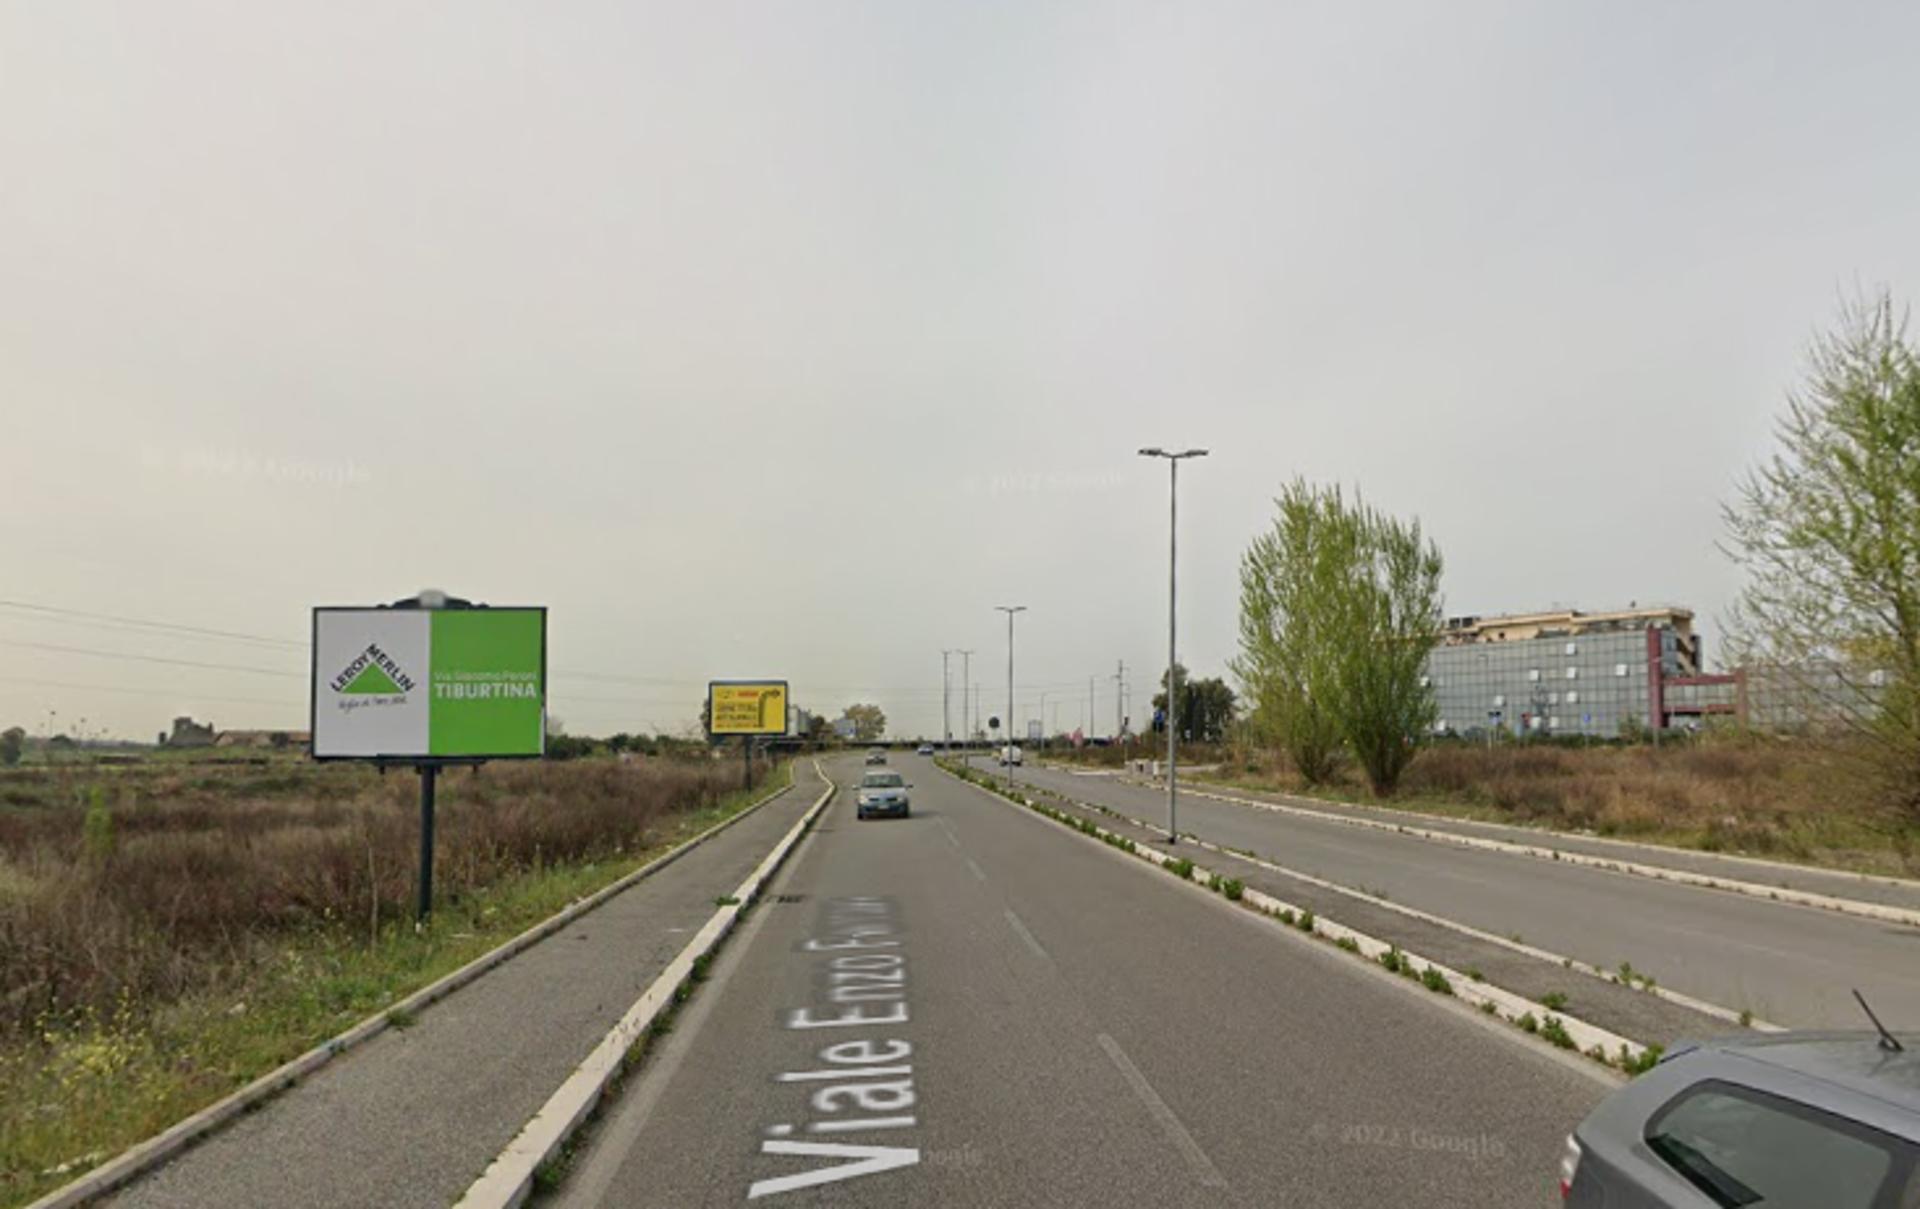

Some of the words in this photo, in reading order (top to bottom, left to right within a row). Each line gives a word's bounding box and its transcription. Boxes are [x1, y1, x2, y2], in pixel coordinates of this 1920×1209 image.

[330, 653, 369, 691] LEROY
[365, 643, 416, 691] MERLIN
[434, 683, 537, 699] TIBURTINA
